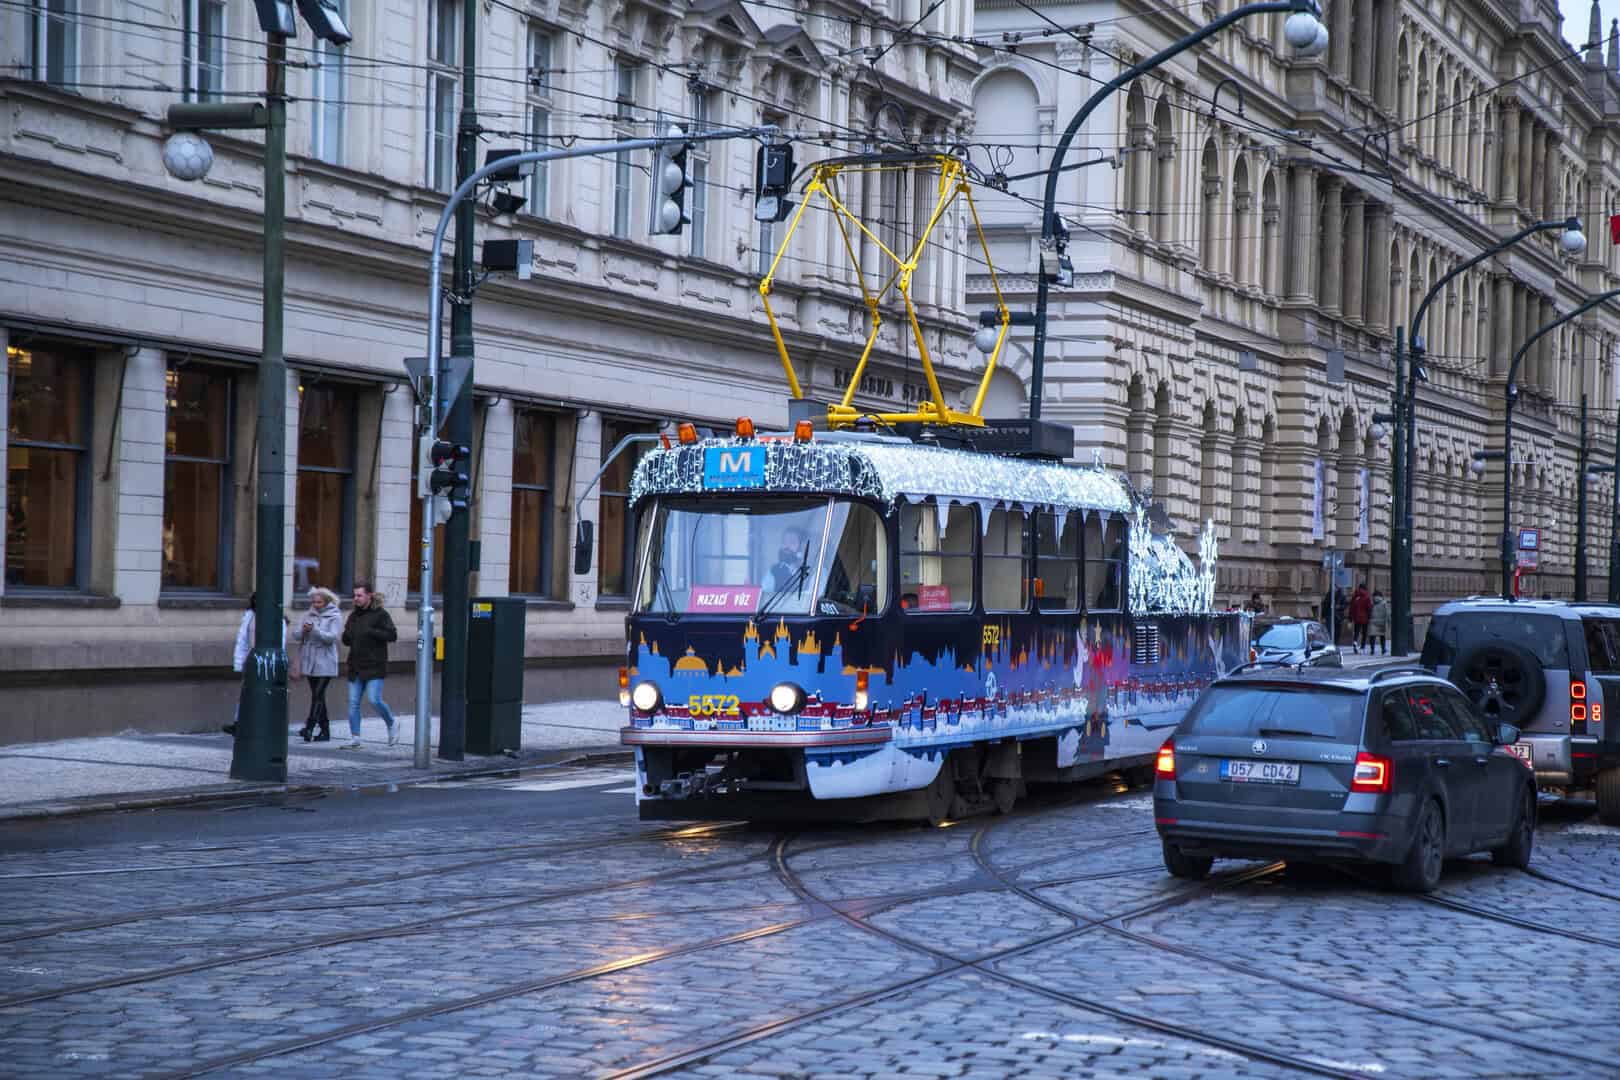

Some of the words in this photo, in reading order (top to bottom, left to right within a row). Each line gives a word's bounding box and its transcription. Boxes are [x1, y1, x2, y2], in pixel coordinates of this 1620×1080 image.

[720, 451, 751, 472] M
[983, 624, 1000, 645] 5572
[688, 694, 740, 716] 5572
[1230, 759, 1253, 776] 057
[1262, 762, 1295, 780] CD42
